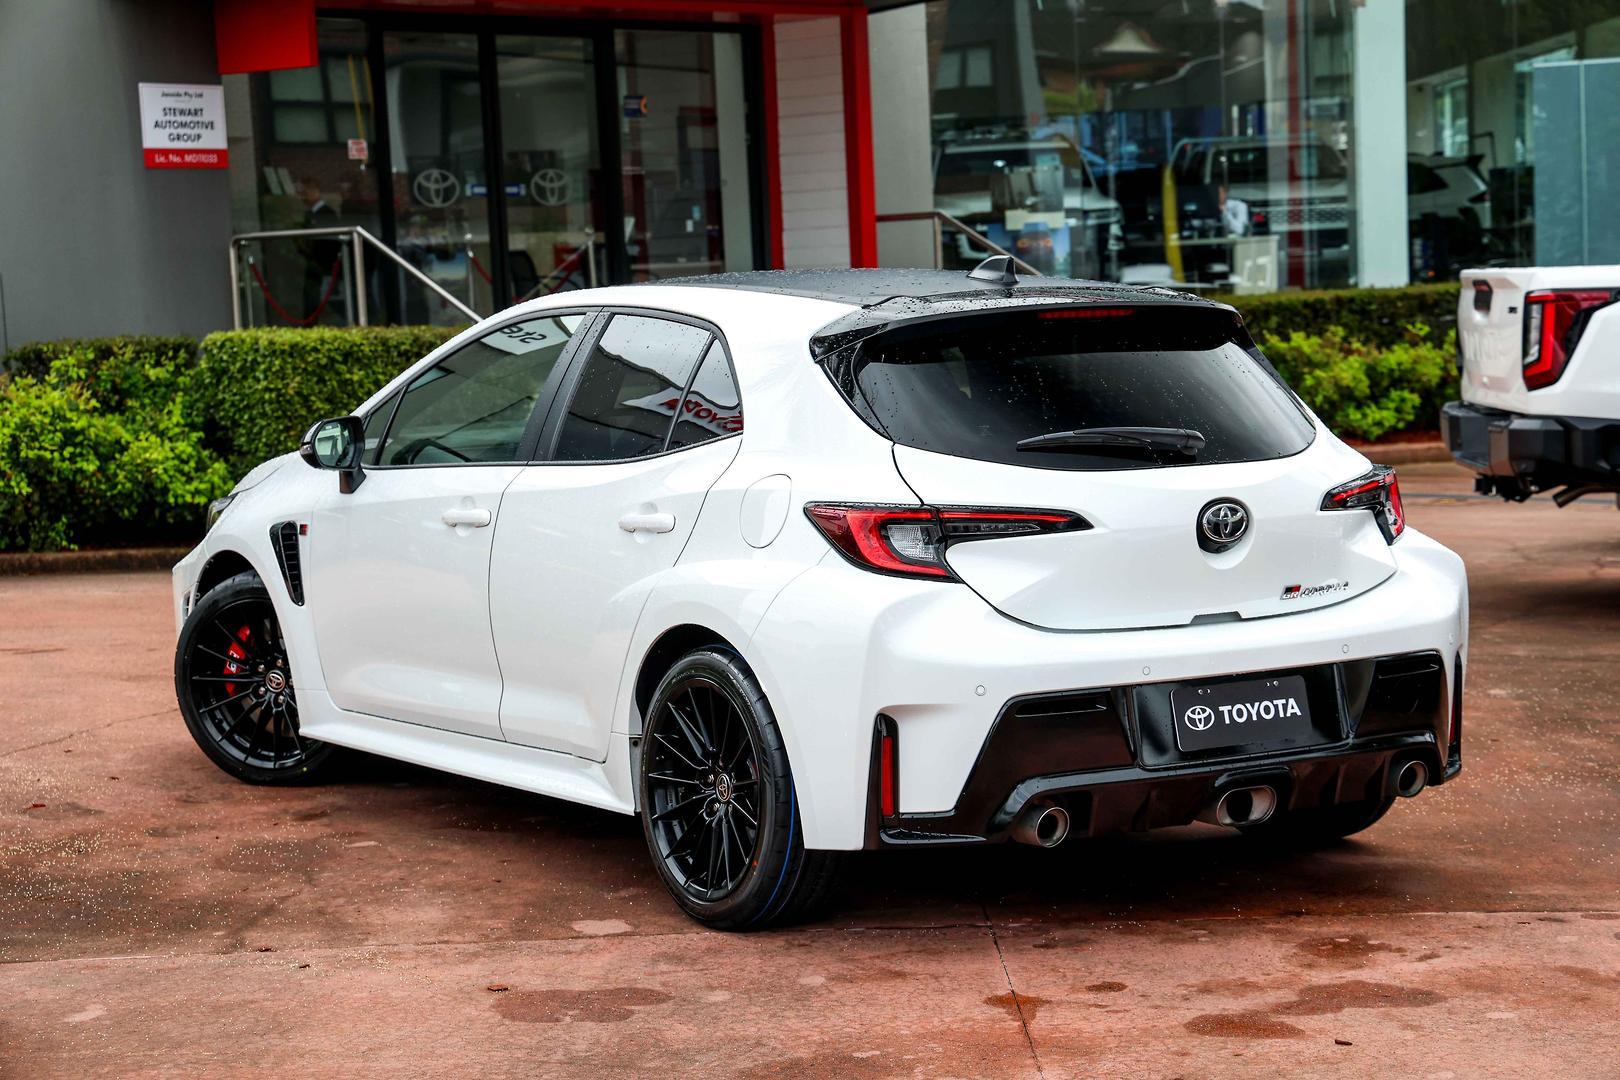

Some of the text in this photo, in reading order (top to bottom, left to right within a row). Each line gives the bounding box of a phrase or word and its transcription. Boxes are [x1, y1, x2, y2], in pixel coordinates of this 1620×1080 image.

[162, 107, 204, 117] STEWART
[154, 120, 215, 130] AUTOMOTIVE
[168, 133, 203, 143] GROUP
[1218, 697, 1302, 725] TOYOTA
